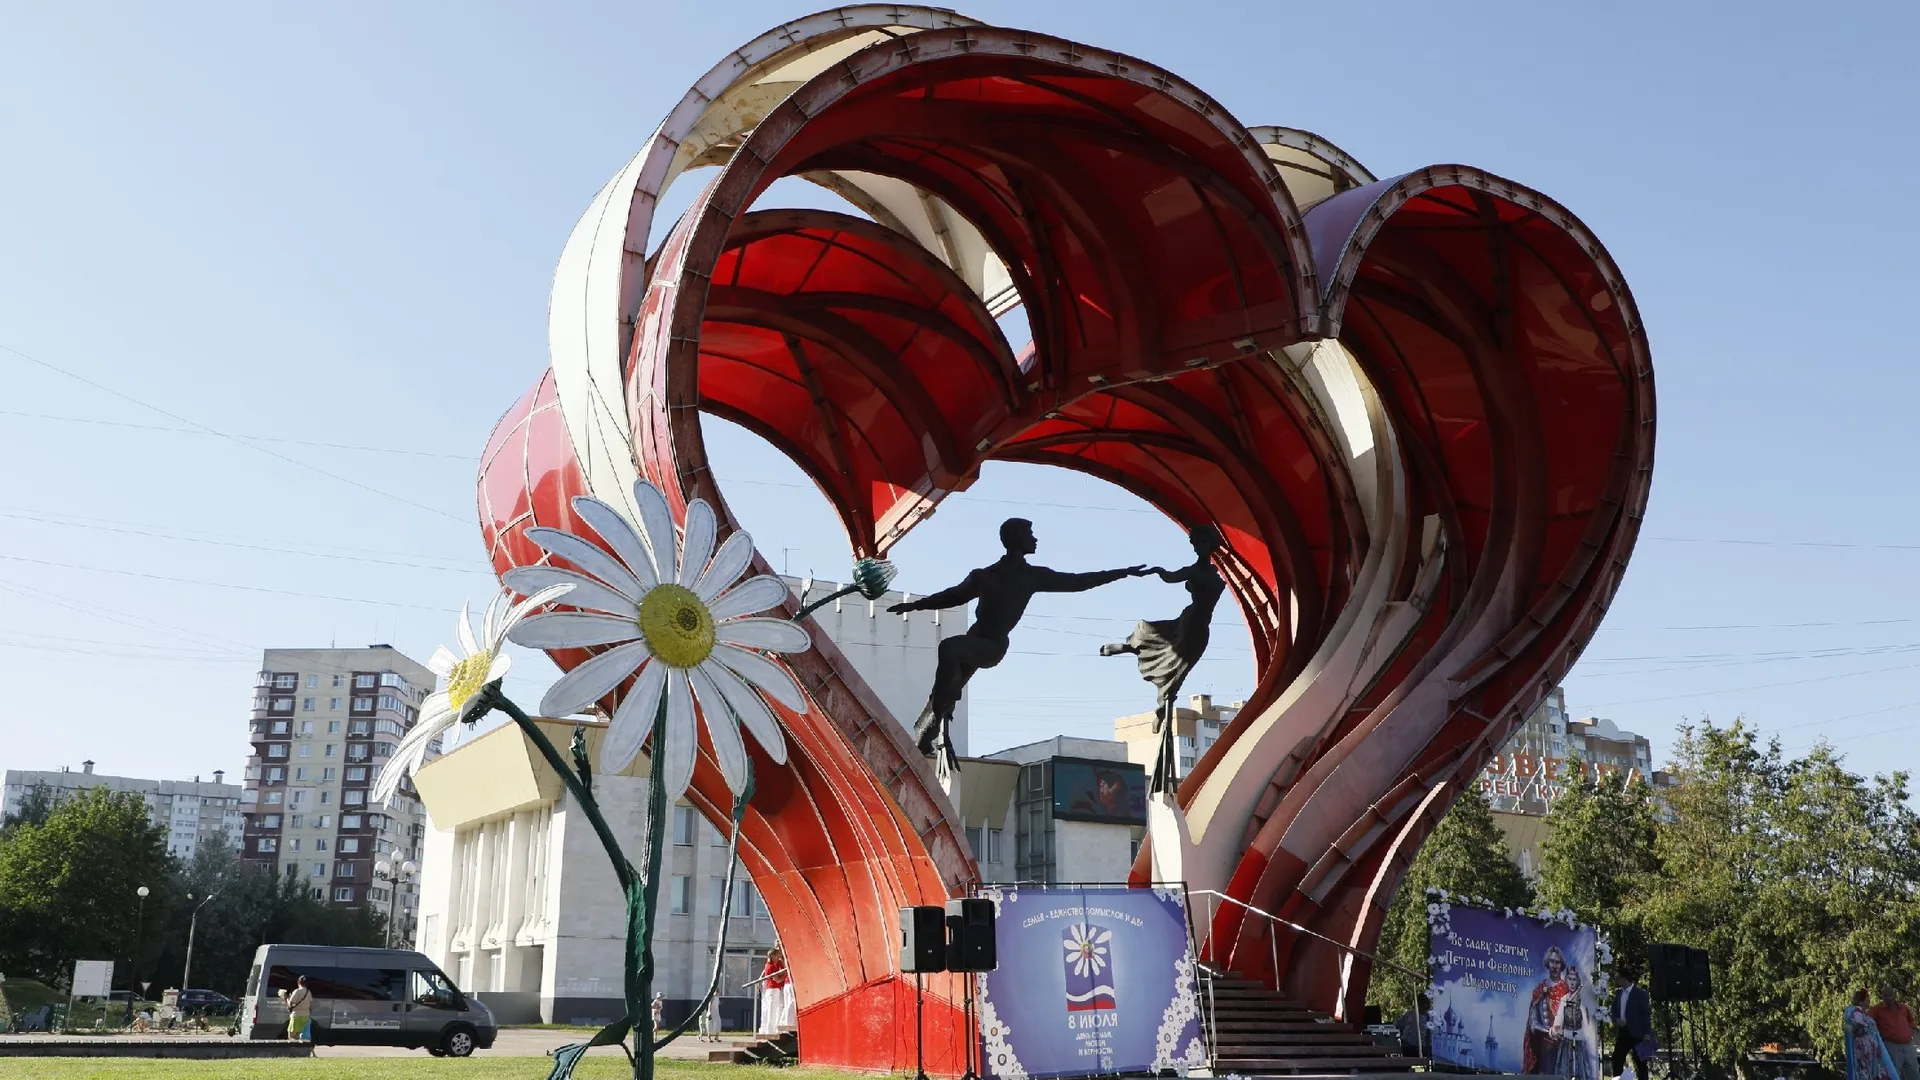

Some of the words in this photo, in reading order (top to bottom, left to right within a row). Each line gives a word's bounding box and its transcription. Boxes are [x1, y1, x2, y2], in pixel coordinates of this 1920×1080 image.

[1022, 912, 1045, 928] СЕМЬЯ
[1050, 907, 1084, 919] ЕДИНСТВО
[1086, 907, 1124, 920] ПОМЫСЛОВ
[1131, 917, 1144, 928] ДЕЛ
[1068, 1014, 1076, 1029] 8
[1080, 1013, 1118, 1029] ИЮЛЯ
[1091, 1031, 1115, 1039] СМЬИ,
